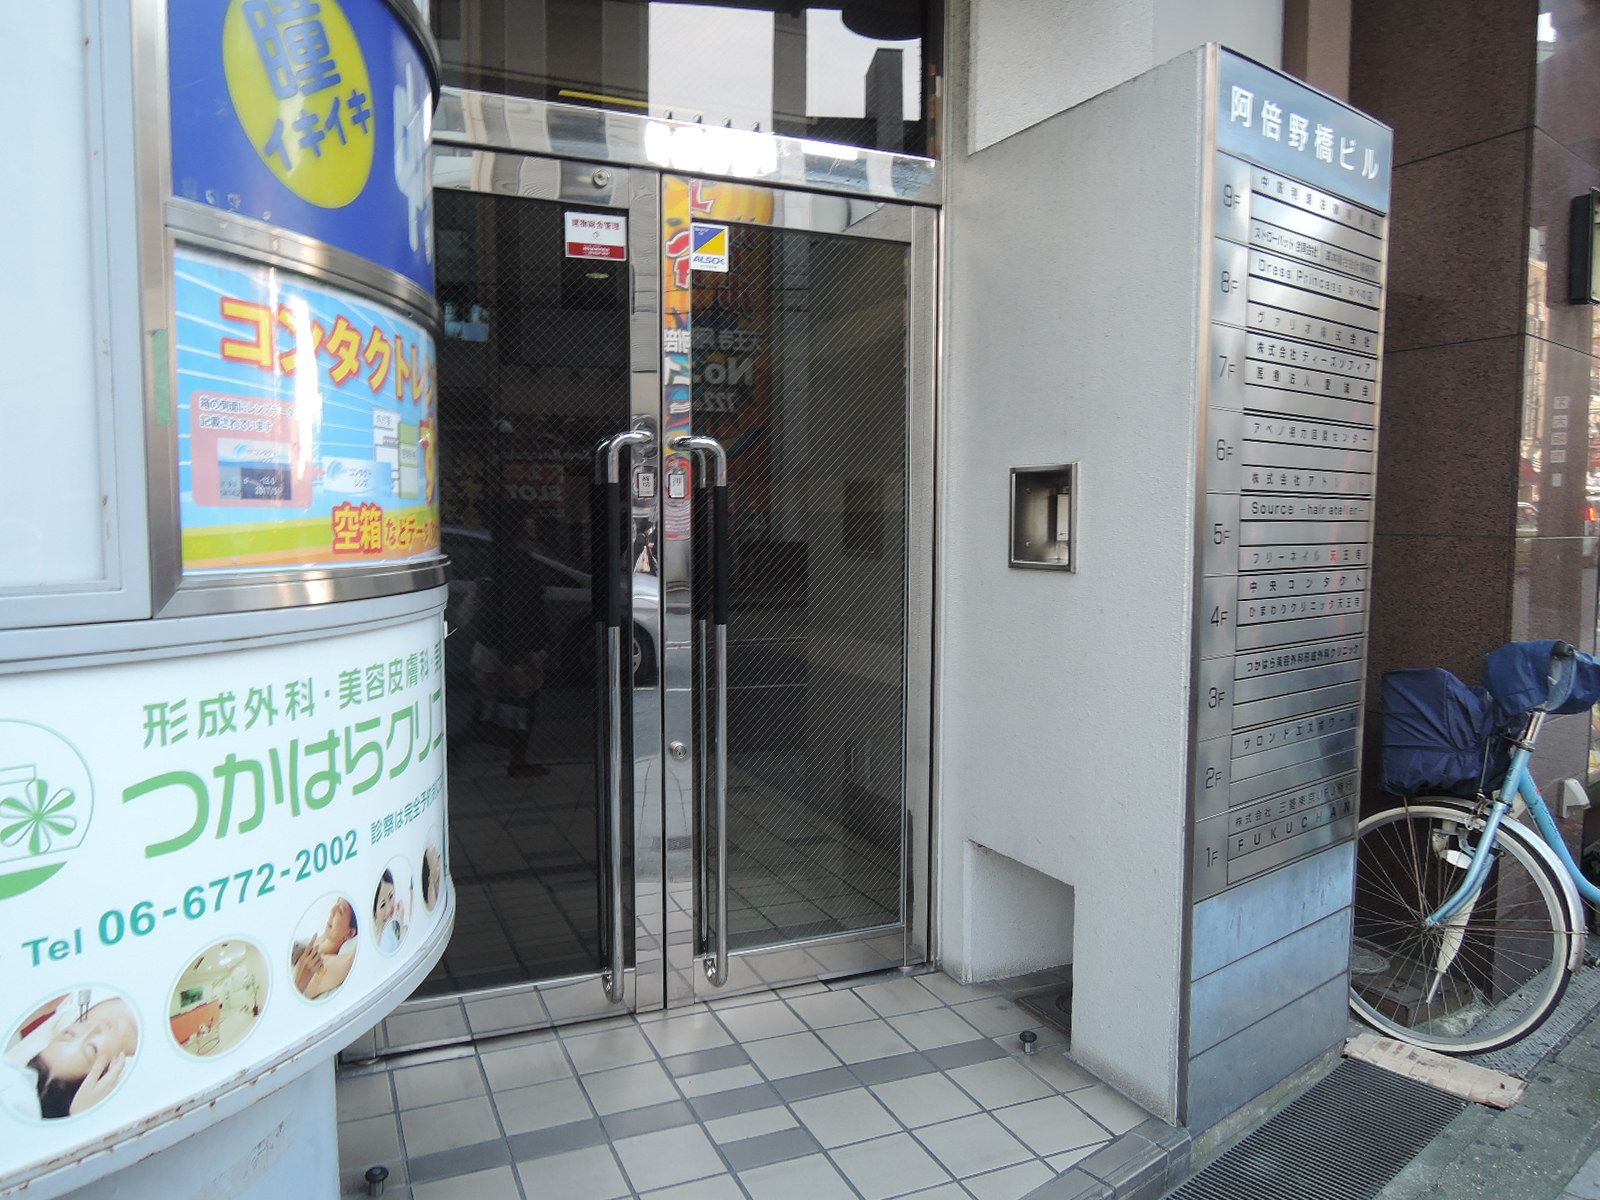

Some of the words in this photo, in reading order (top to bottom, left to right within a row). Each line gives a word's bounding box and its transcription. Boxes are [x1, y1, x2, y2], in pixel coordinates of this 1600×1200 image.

[264, 89, 371, 171] イキイキ
[1230, 86, 1378, 180] 阿倍野橋ビル
[1223, 184, 1241, 209] 9F
[693, 256, 725, 264] ALSOK
[1221, 270, 1238, 294] 8F
[1219, 355, 1236, 379] 7F
[1216, 438, 1233, 461] 6F
[1250, 500, 1294, 515] Source
[1214, 524, 1230, 545] 5F
[1211, 606, 1227, 627] 4F
[1208, 687, 1225, 709] 3F
[1205, 767, 1222, 790] 2F
[1237, 800, 1350, 852] FUKUCHAN
[1206, 848, 1218, 868] 1F
[21, 928, 83, 968] Tel
[98, 828, 359, 947] 06-6772-2002
